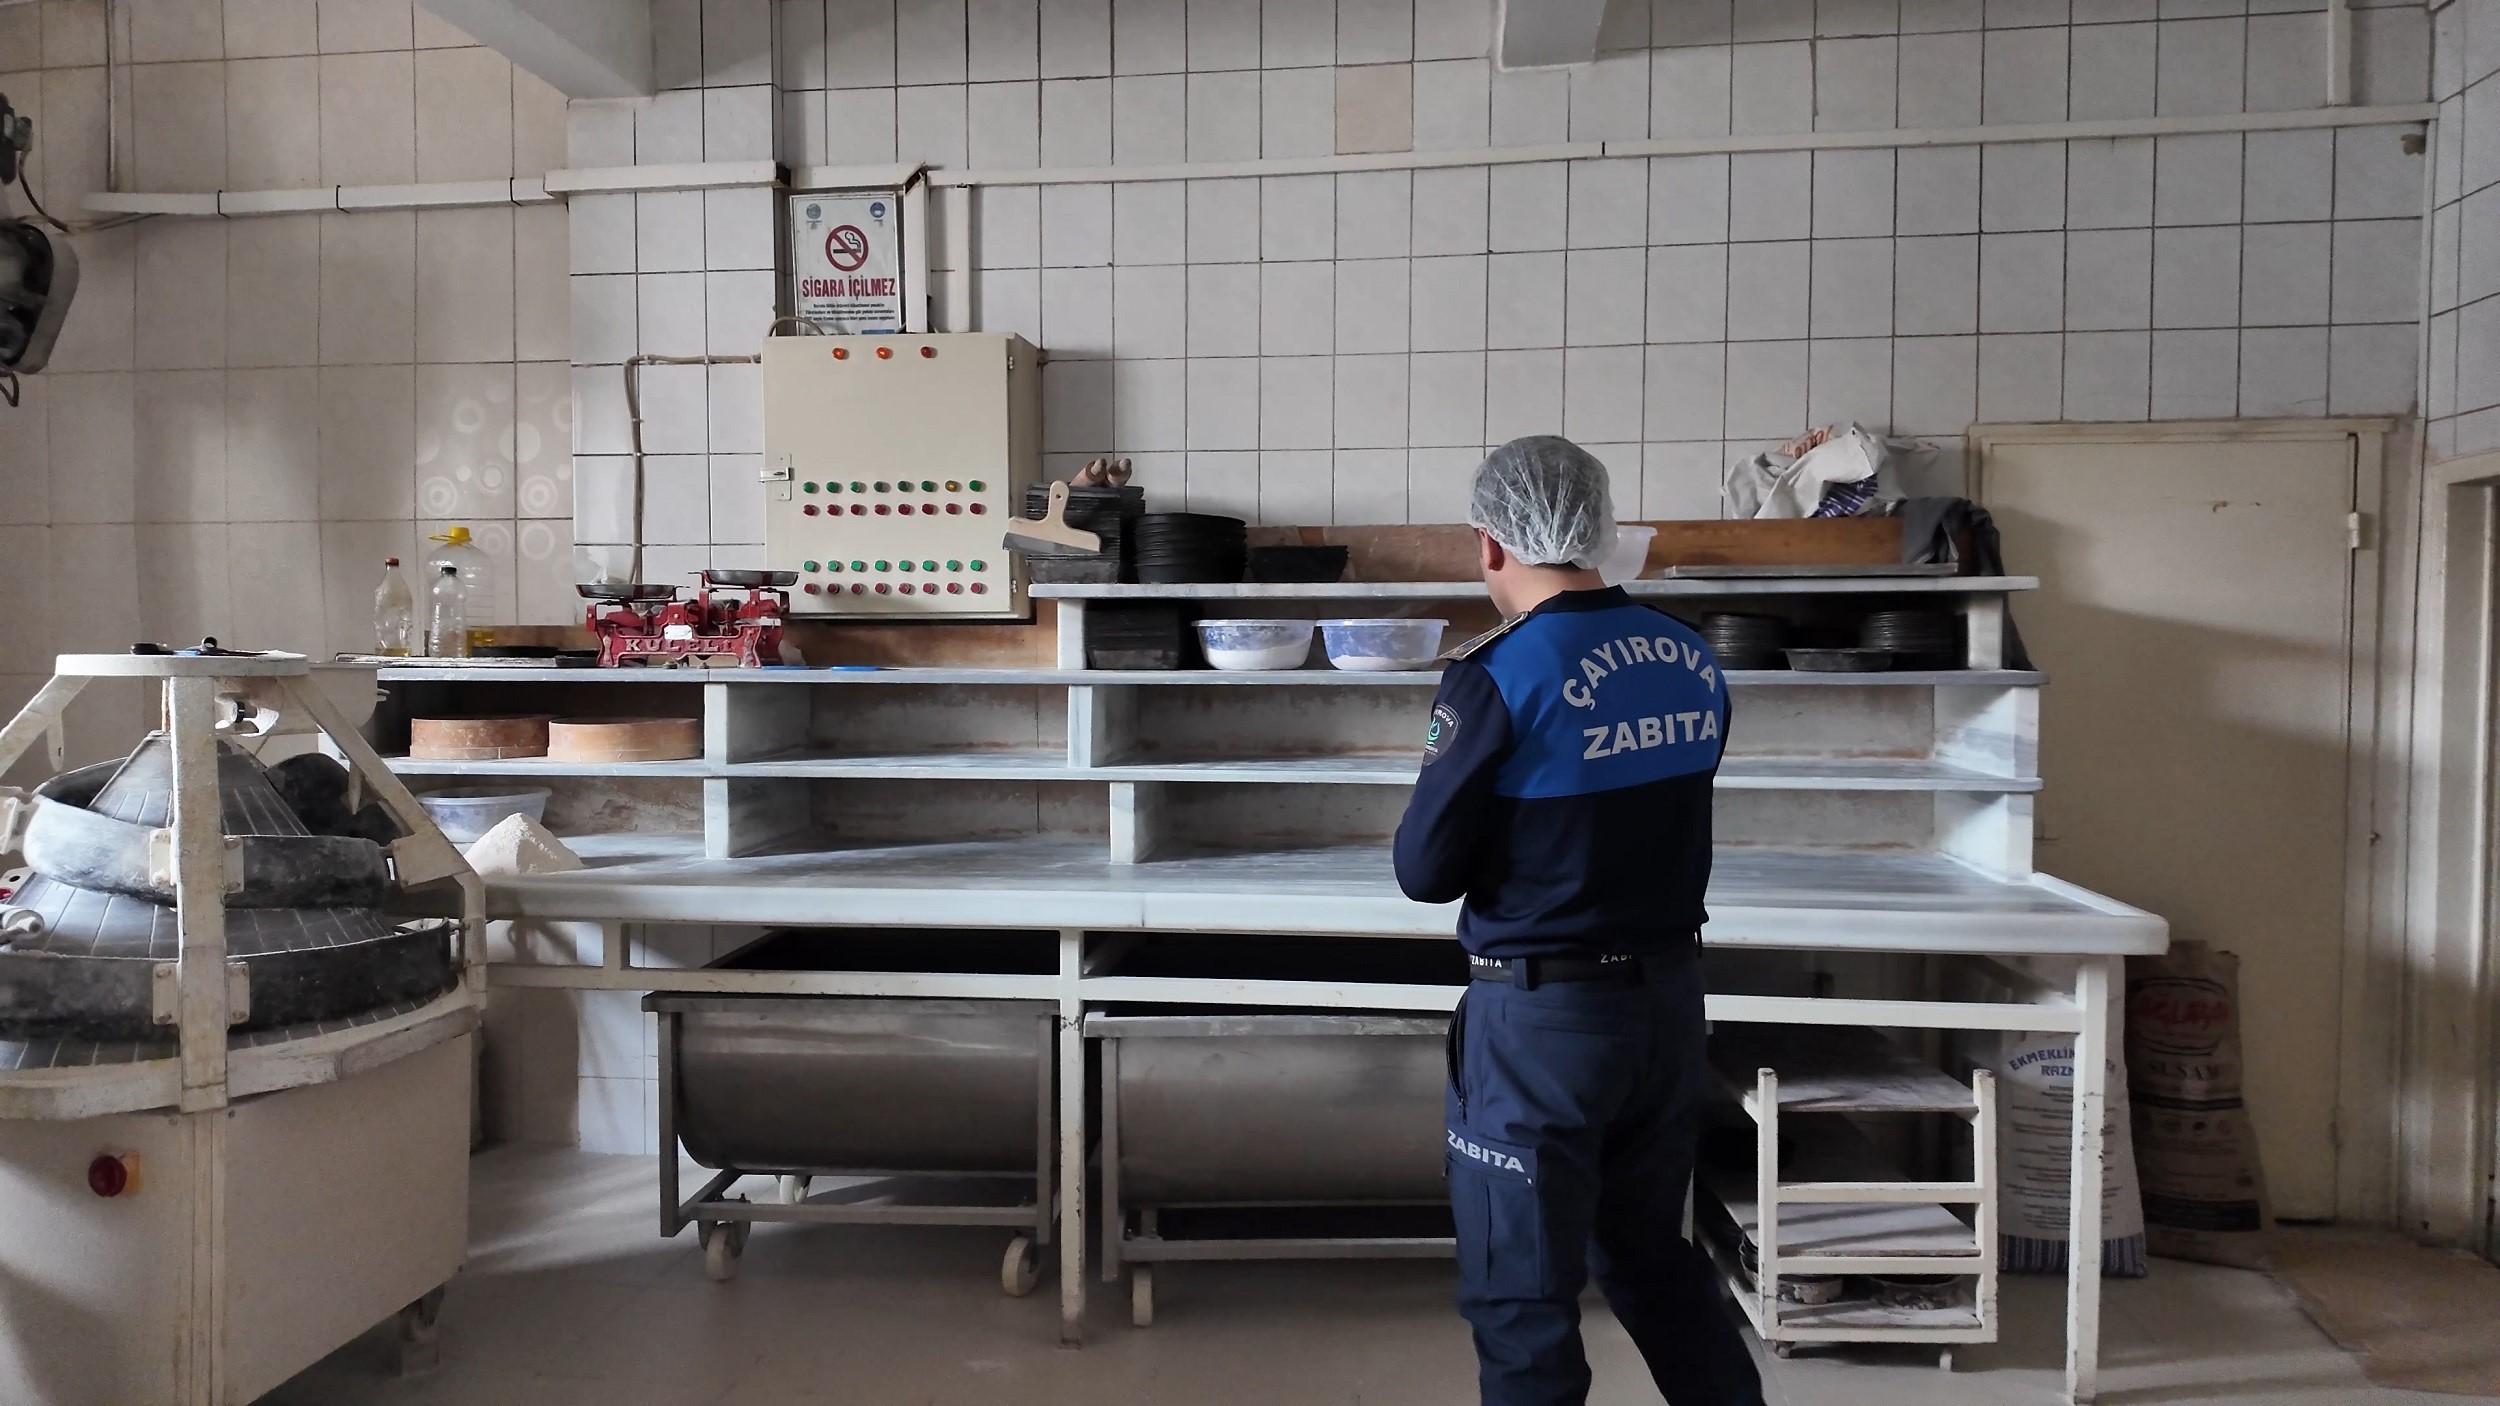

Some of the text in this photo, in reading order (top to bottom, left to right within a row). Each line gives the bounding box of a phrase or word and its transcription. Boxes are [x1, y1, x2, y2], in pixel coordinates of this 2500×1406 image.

[802, 275, 896, 301] SİGARA İÇİLMEZ
[1562, 636, 1717, 711] ÇAYIROVA
[1583, 710, 1719, 761] ZABITA
[1447, 1129, 1525, 1174] ZABITA
